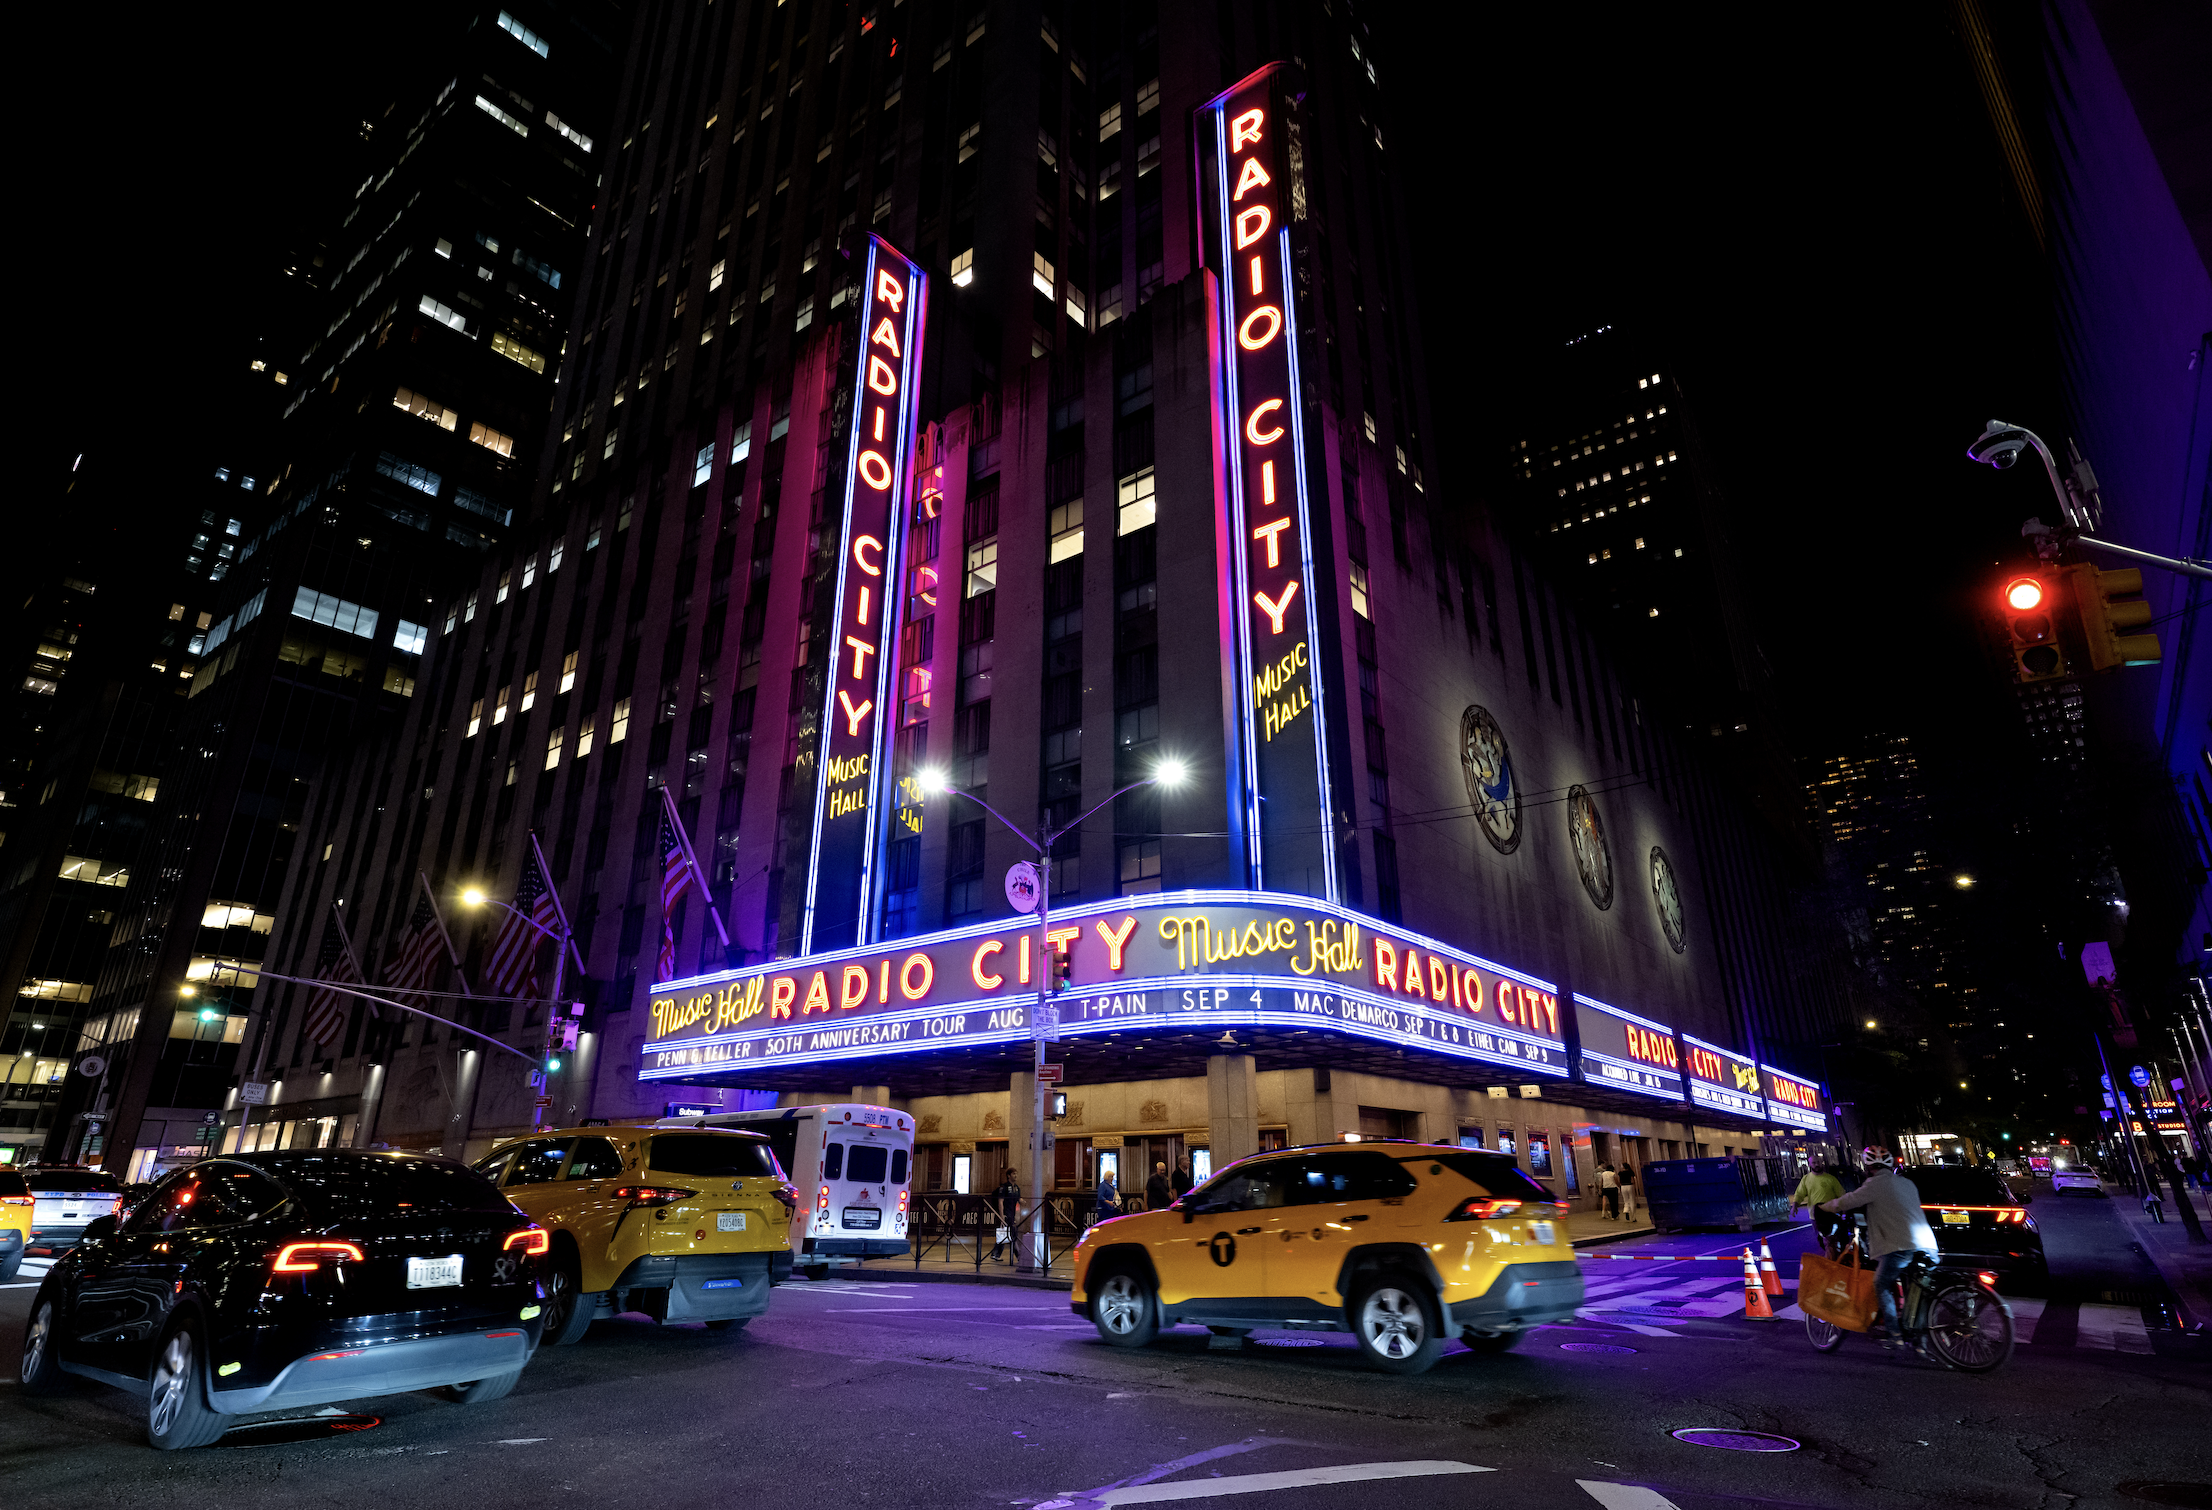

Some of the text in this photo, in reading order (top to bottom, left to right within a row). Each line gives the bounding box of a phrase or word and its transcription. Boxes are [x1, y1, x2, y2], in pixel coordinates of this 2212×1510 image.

[1231, 107, 1299, 635] RADIO CITY
[838, 268, 904, 737] RADIO CITY
[1254, 641, 1307, 709] MUSIC
[1265, 683, 1310, 743] HALL
[827, 753, 869, 787] MUSIC
[829, 788, 867, 820] HALL
[770, 915, 1138, 1020] RADIO CITY
[1158, 915, 1363, 976] Music Hall
[652, 974, 765, 1039] Music Hall
[1374, 937, 1556, 1033] RADIO CITY
[657, 1049, 687, 1068] PENN
[704, 1041, 751, 1062] TELLER
[765, 1035, 802, 1056] 50TH
[810, 1022, 911, 1050] ANNIVERSARY
[922, 1015, 966, 1037] TOUR
[987, 1007, 1024, 1030] AUG
[1080, 993, 1147, 1019] T-PAIN
[1181, 989, 1229, 1011] SEP
[1249, 990, 1263, 1009] 4
[1294, 991, 1335, 1016] MAC
[1341, 999, 1399, 1029] DEMARCO
[1404, 1015, 1424, 1035] SEP
[1429, 1020, 1436, 1036] 7
[1452, 1026, 1459, 1043] 8
[1468, 1030, 1495, 1051] ETHEL
[1498, 1038, 1518, 1056] CAIN
[1525, 1044, 1539, 1060] SEP
[1541, 1048, 1548, 1063] 9
[1626, 1024, 1677, 1068] RADIO
[1693, 1047, 1722, 1082] CITY
[1772, 1075, 1799, 1105] RADIO
[1799, 1084, 1818, 1109] CITY
[679, 1108, 705, 1116] Subway
[414, 1266, 458, 1282] T118344C
[1214, 1239, 1231, 1263] T
